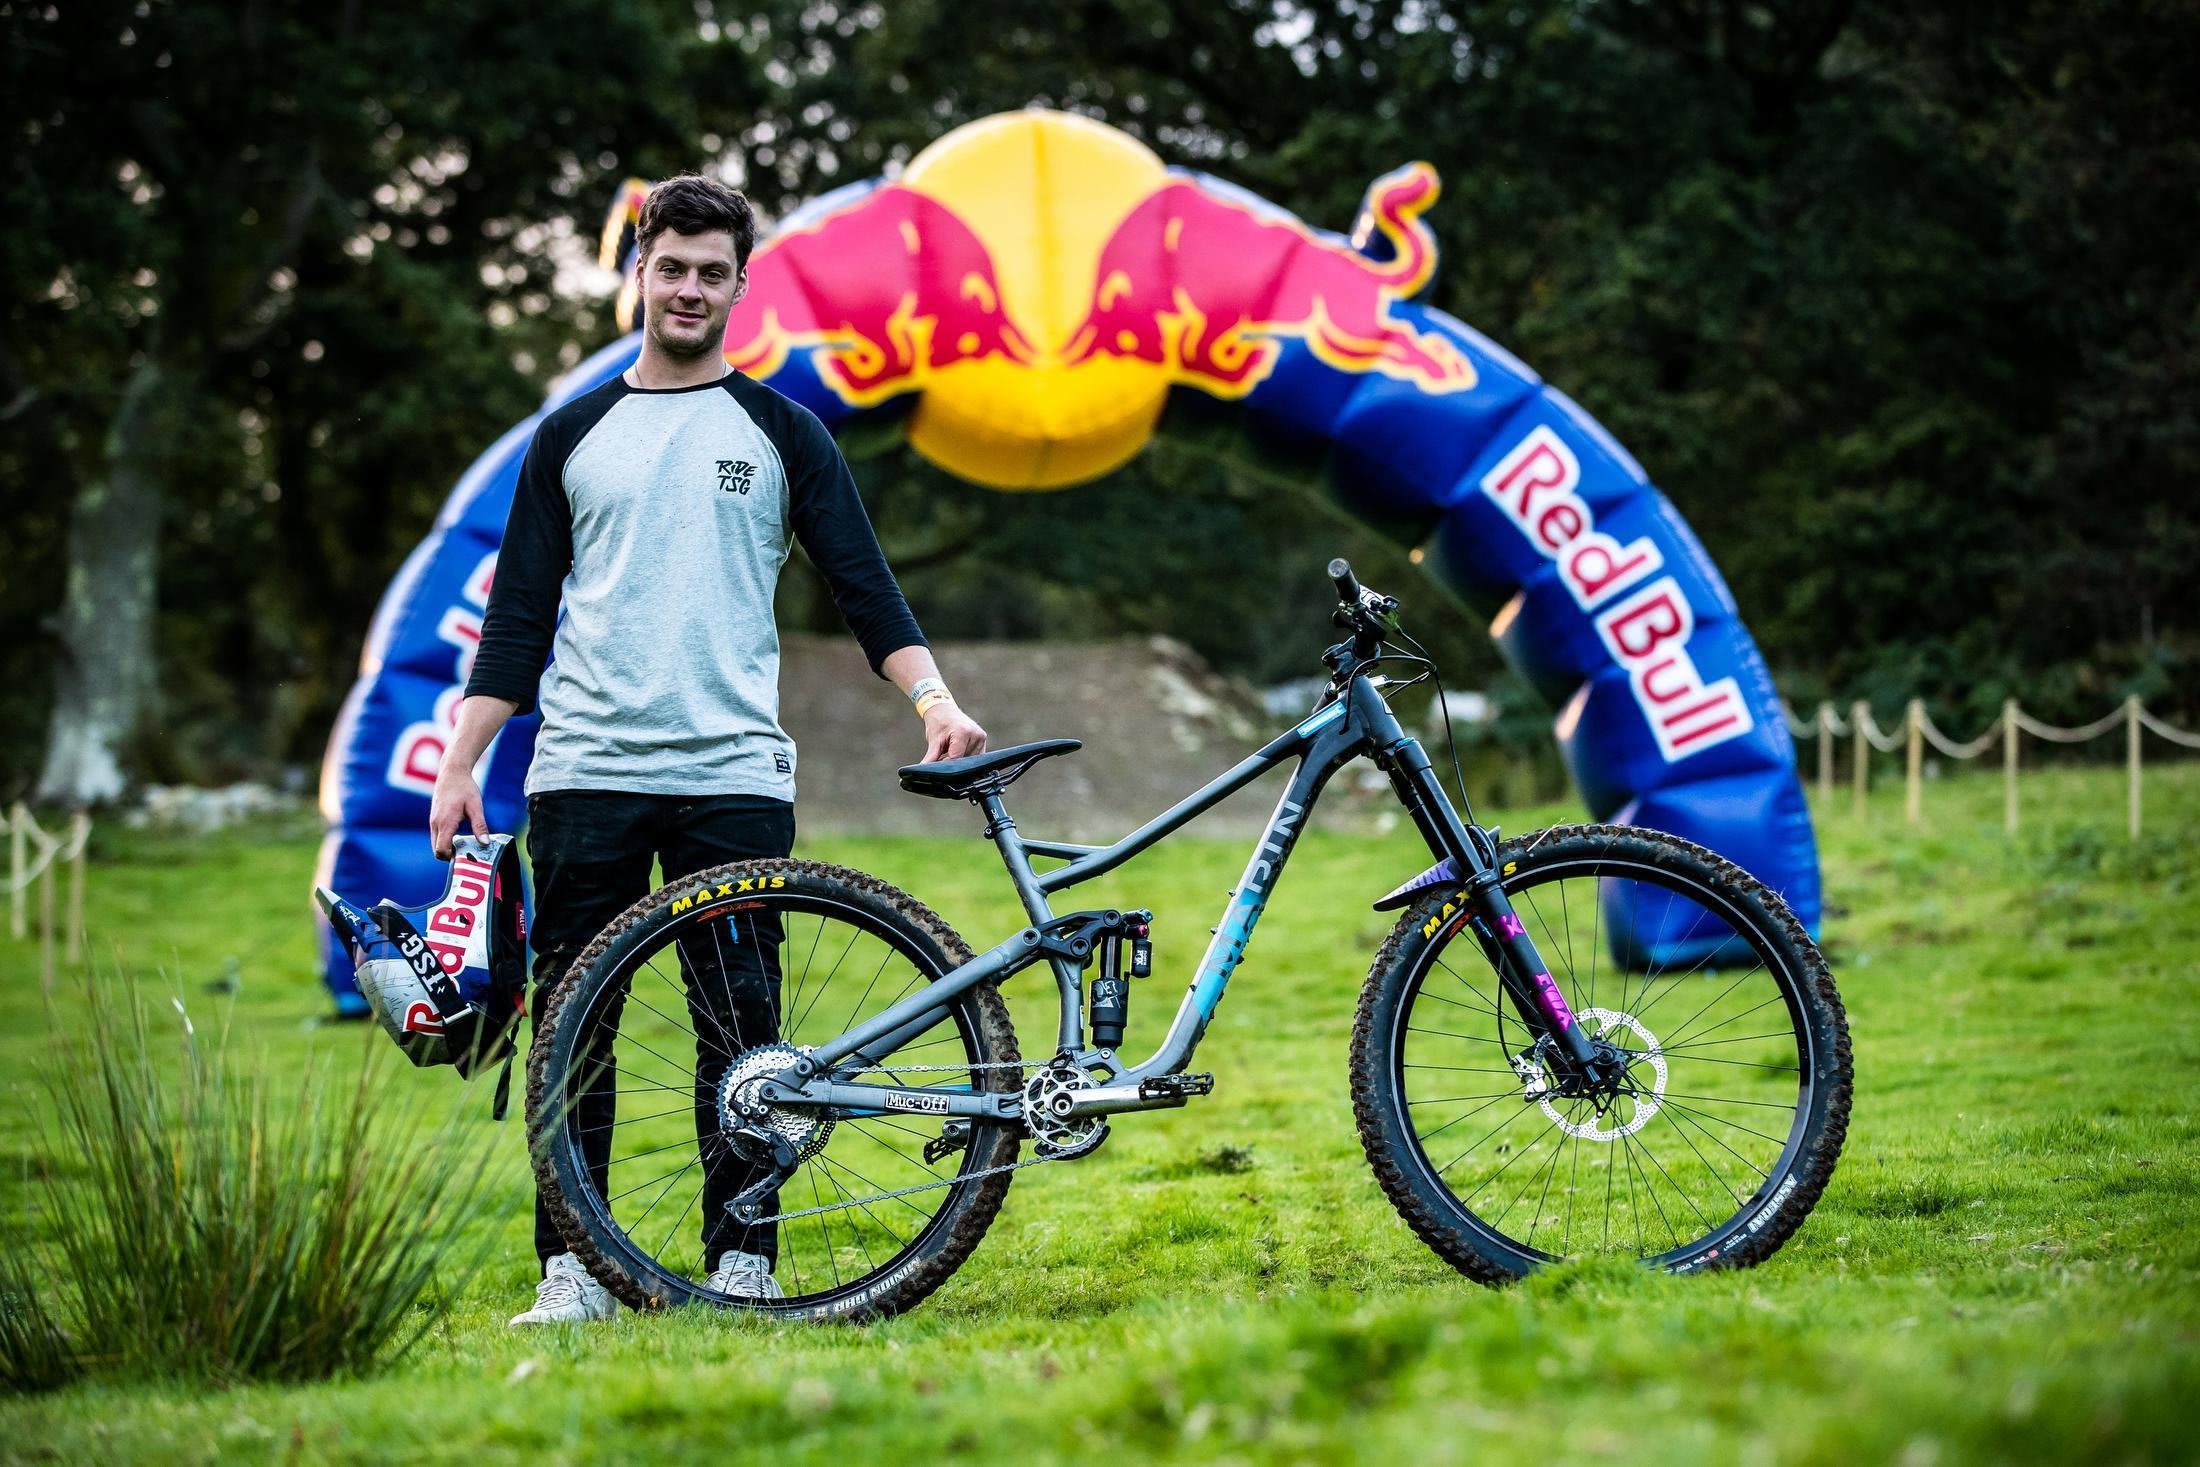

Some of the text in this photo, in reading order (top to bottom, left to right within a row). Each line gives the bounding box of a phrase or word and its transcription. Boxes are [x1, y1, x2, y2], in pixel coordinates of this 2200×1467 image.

[715, 460, 758, 477] RIDE
[717, 475, 751, 495] TSG
[1492, 439, 1740, 749] Red Bull
[429, 856, 494, 938] Bull
[671, 876, 786, 916] MAXXIS
[1206, 800, 1304, 978] MARIN
[1422, 861, 1518, 940] MAXS
[401, 932, 446, 993] TSG
[404, 940, 467, 1036] Rd
[888, 1093, 948, 1111] Muc-Off
[869, 1256, 922, 1298] MINION
